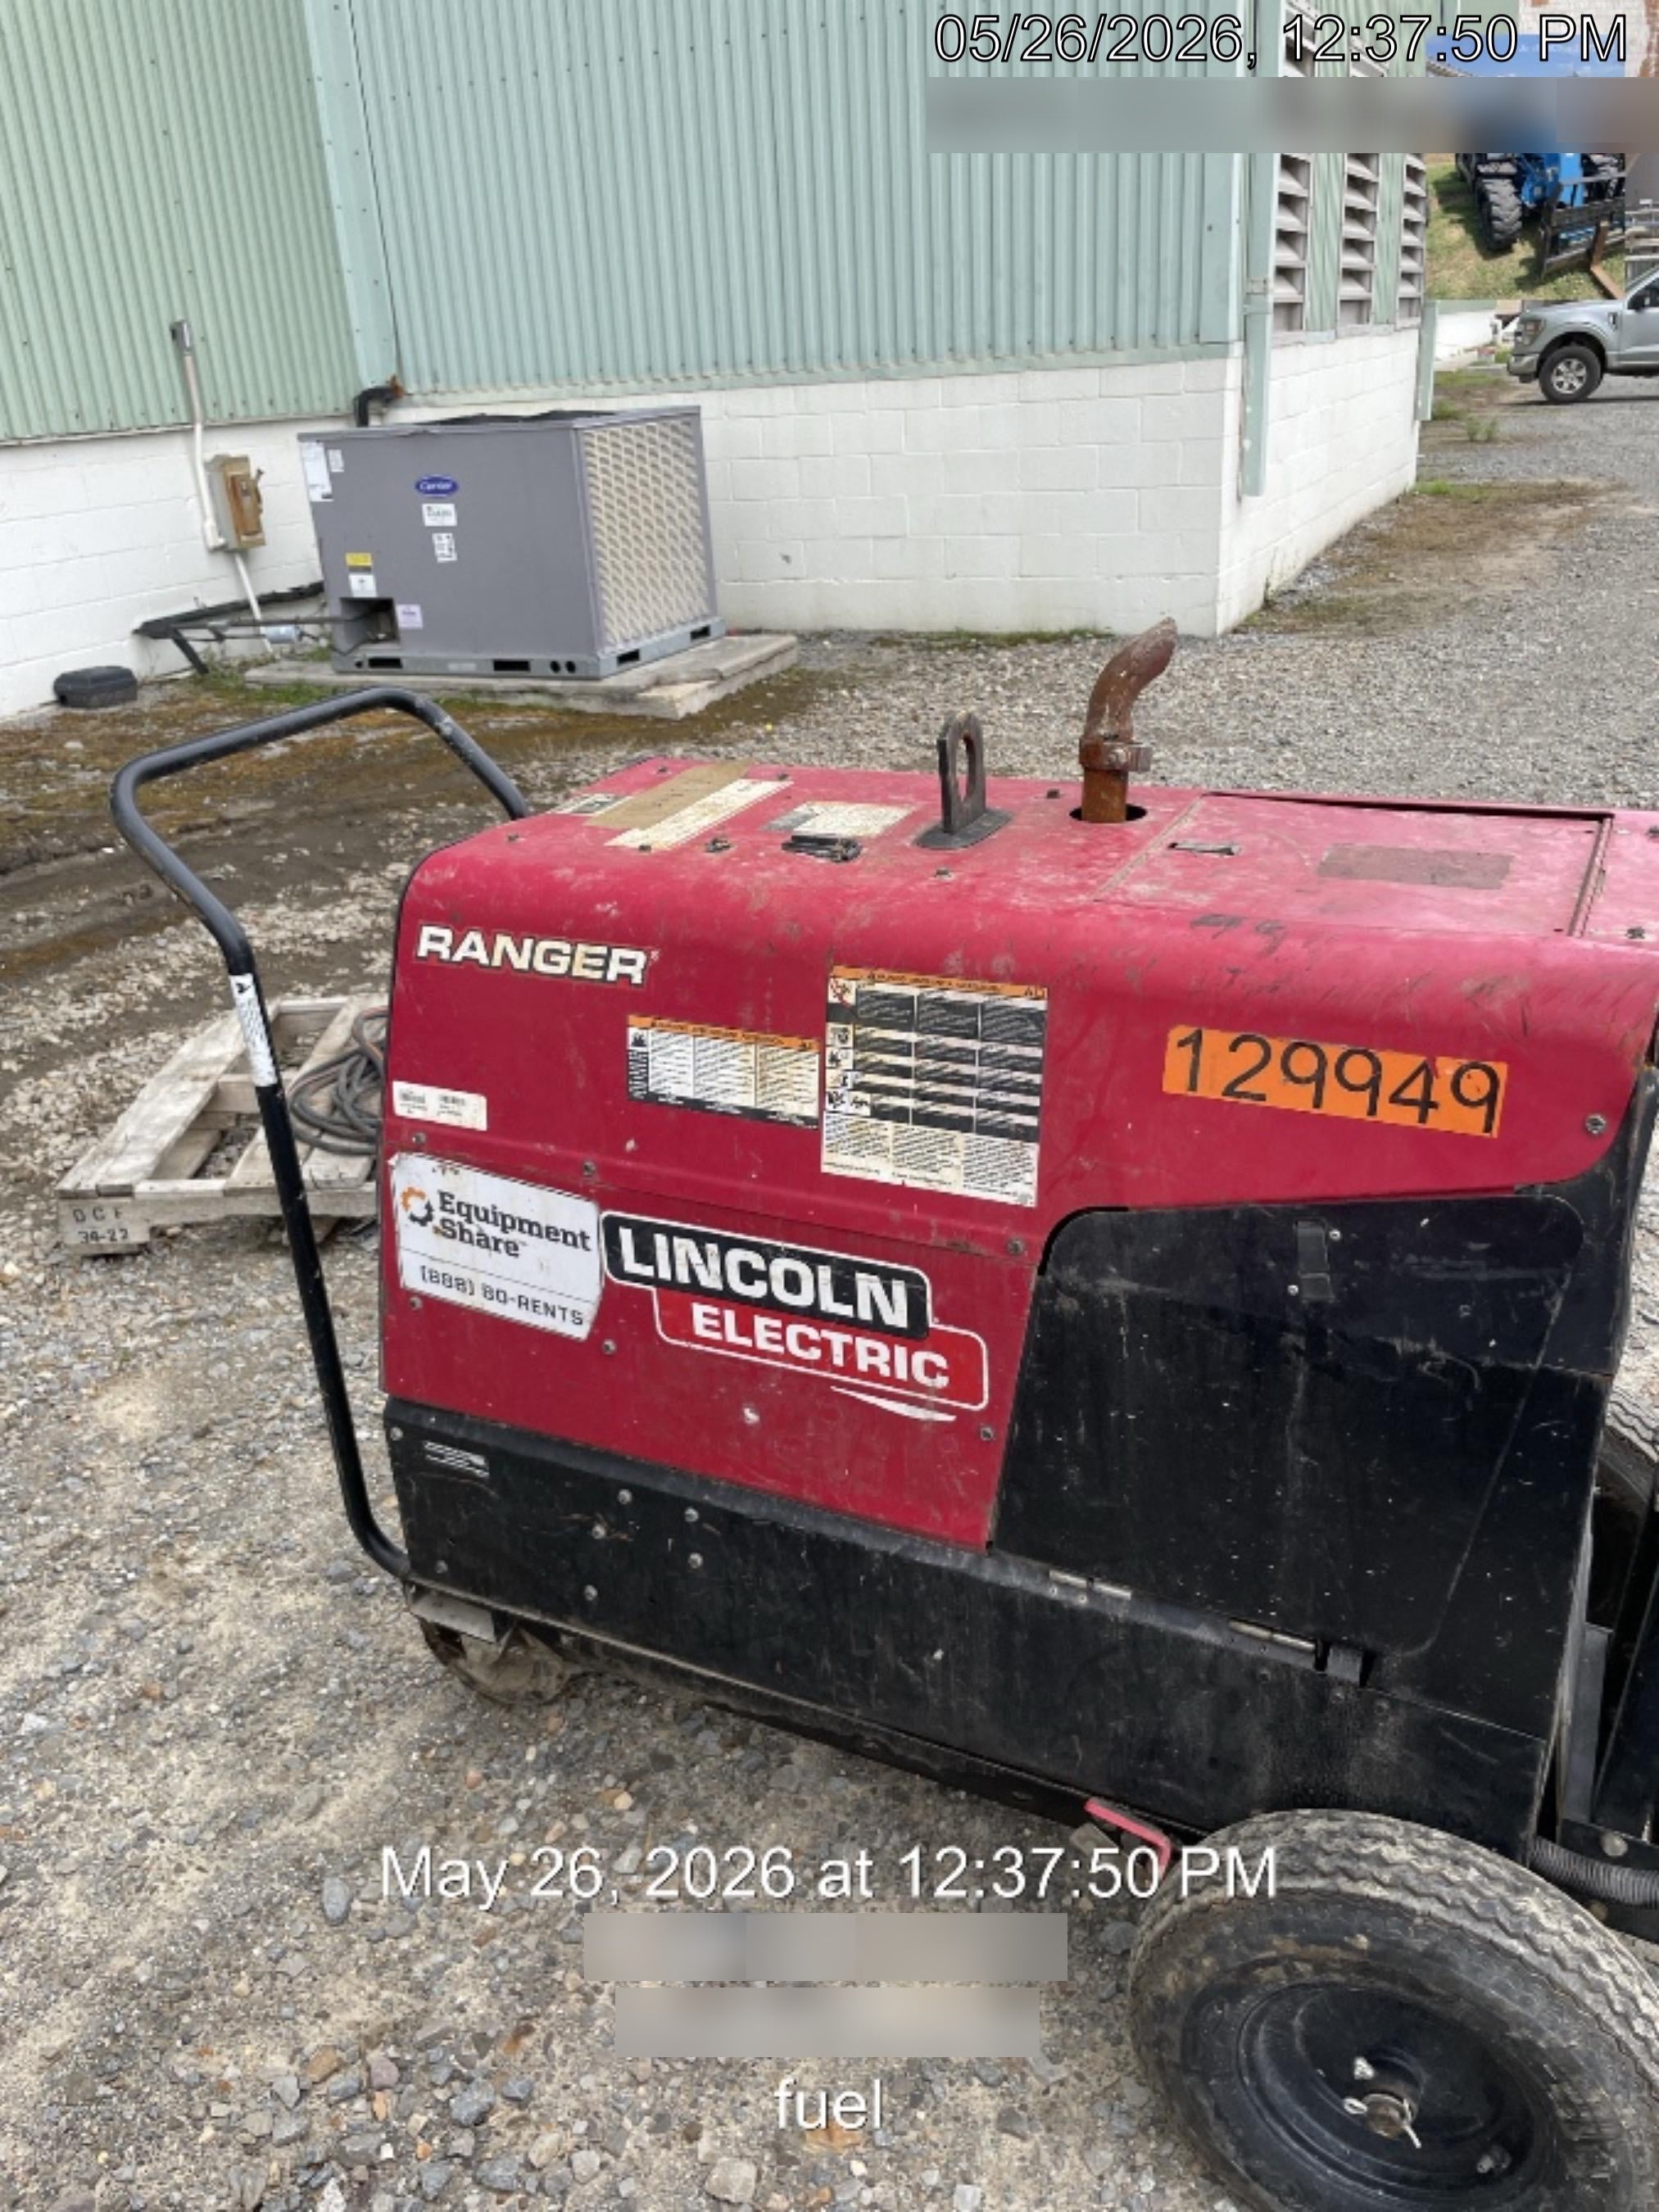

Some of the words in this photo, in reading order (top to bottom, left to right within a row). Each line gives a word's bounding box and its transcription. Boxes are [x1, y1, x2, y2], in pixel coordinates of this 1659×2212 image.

[416, 925, 647, 985] RANGER
[1176, 1028, 1500, 1134] 129949
[437, 1189, 592, 1253] Equipment
[439, 1217, 520, 1258] Share
[420, 1265, 475, 1296] (888)
[482, 1283, 584, 1326] 80-RENTS
[618, 1226, 909, 1329] LINCOLN
[691, 1301, 950, 1390] ELECTRIC
